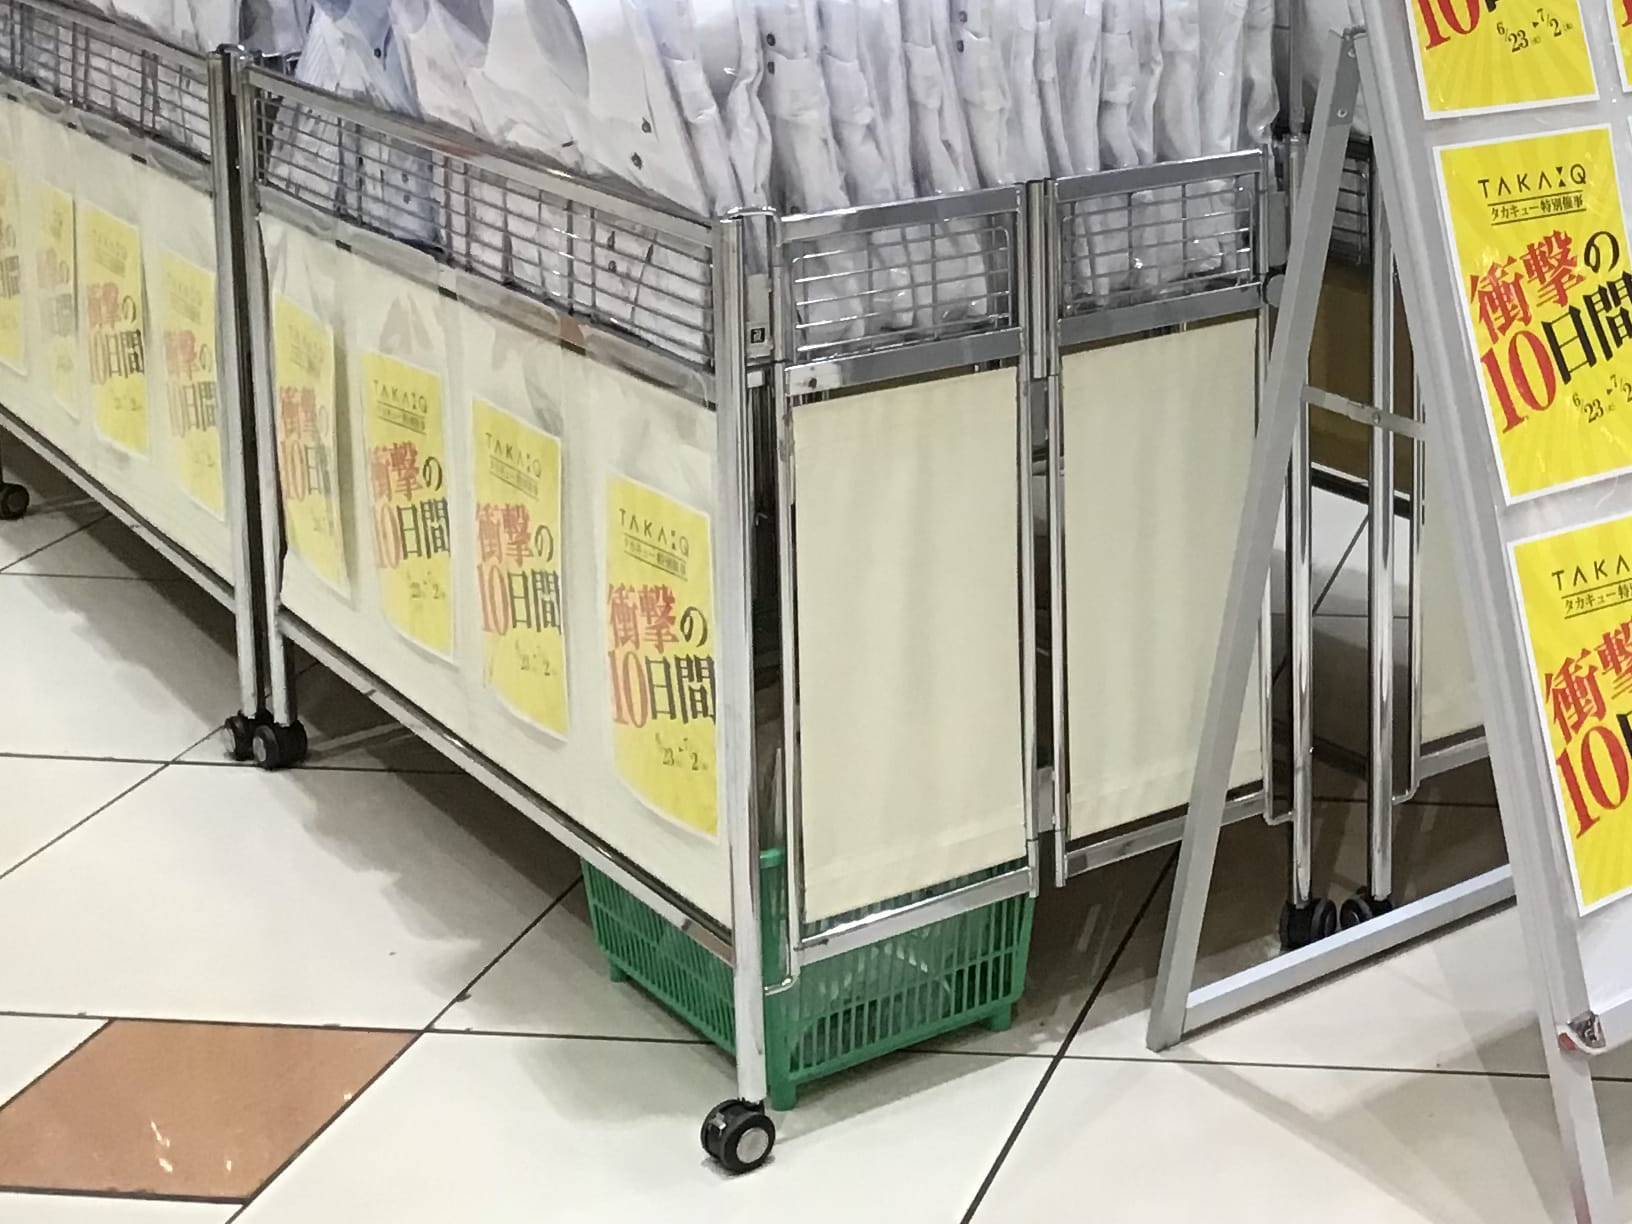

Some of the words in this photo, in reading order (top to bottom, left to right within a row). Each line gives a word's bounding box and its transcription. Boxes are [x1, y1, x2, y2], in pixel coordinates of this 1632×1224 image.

[1469, 230, 1620, 344] 衝撃の
[373, 496, 451, 570] 10日間
[477, 564, 562, 636] 10日間
[607, 583, 708, 654] 衝撃の
[608, 650, 717, 730] 10日間
